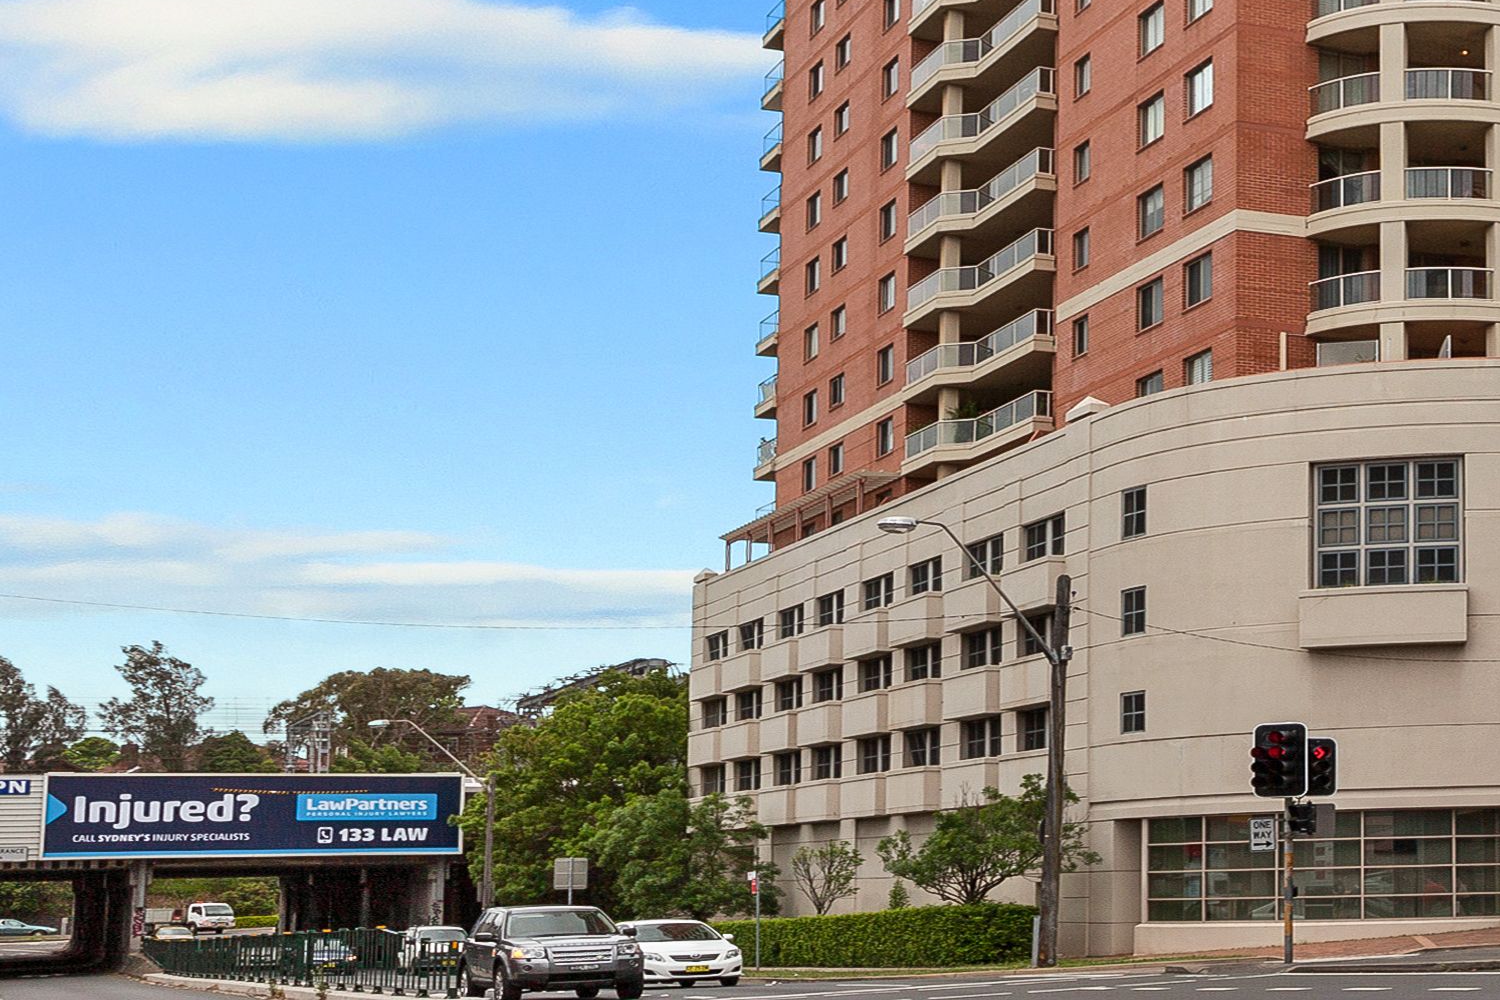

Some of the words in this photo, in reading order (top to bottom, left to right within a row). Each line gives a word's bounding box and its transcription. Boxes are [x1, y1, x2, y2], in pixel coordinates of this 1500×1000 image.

[306, 798, 428, 811] LawPartners
[74, 793, 260, 830] Injured?
[1253, 820, 1272, 829] ONE
[72, 834, 97, 843] CALL
[98, 833, 151, 842] SYDNEY'S
[152, 833, 189, 842] INJURY
[190, 832, 251, 841] SPECIALISTS
[338, 828, 376, 842] 133
[381, 827, 429, 841] LAW
[1253, 831, 1272, 839] WAY
